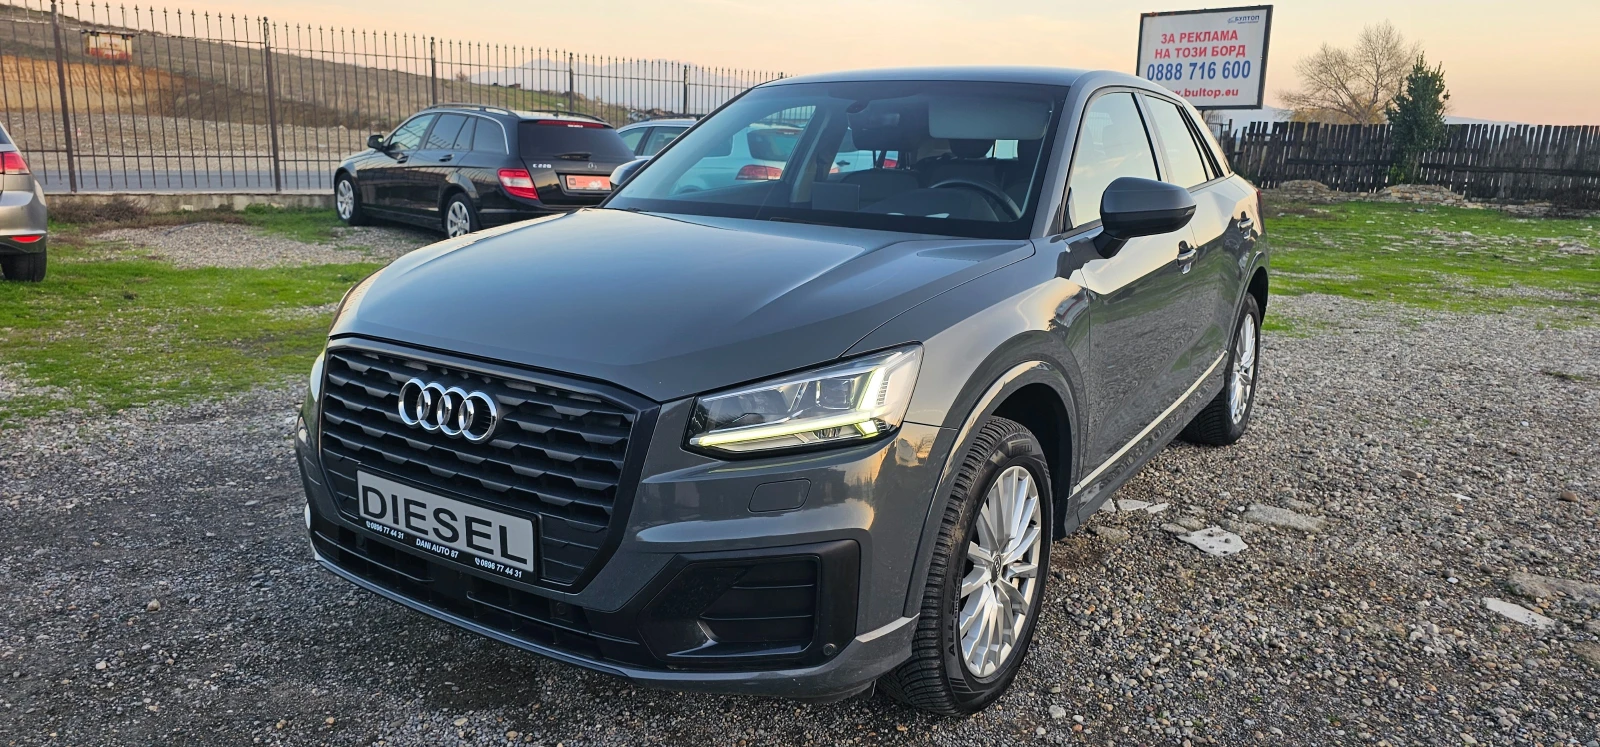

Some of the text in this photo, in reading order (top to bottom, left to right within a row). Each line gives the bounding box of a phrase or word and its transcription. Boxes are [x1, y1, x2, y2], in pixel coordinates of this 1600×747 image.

[1160, 30, 1238, 44] ЗА РЕКЛАМА
[1154, 45, 1246, 59] НА ТОЗИ БОРД
[1147, 60, 1251, 81] 0888 716 600
[1172, 87, 1239, 99] w.bultop.eu
[361, 485, 528, 565] DIESEL
[370, 521, 404, 539] 0896 77 44 31
[416, 538, 459, 559] DANI AUTO 87
[480, 559, 522, 578] 0896 77 44 31
